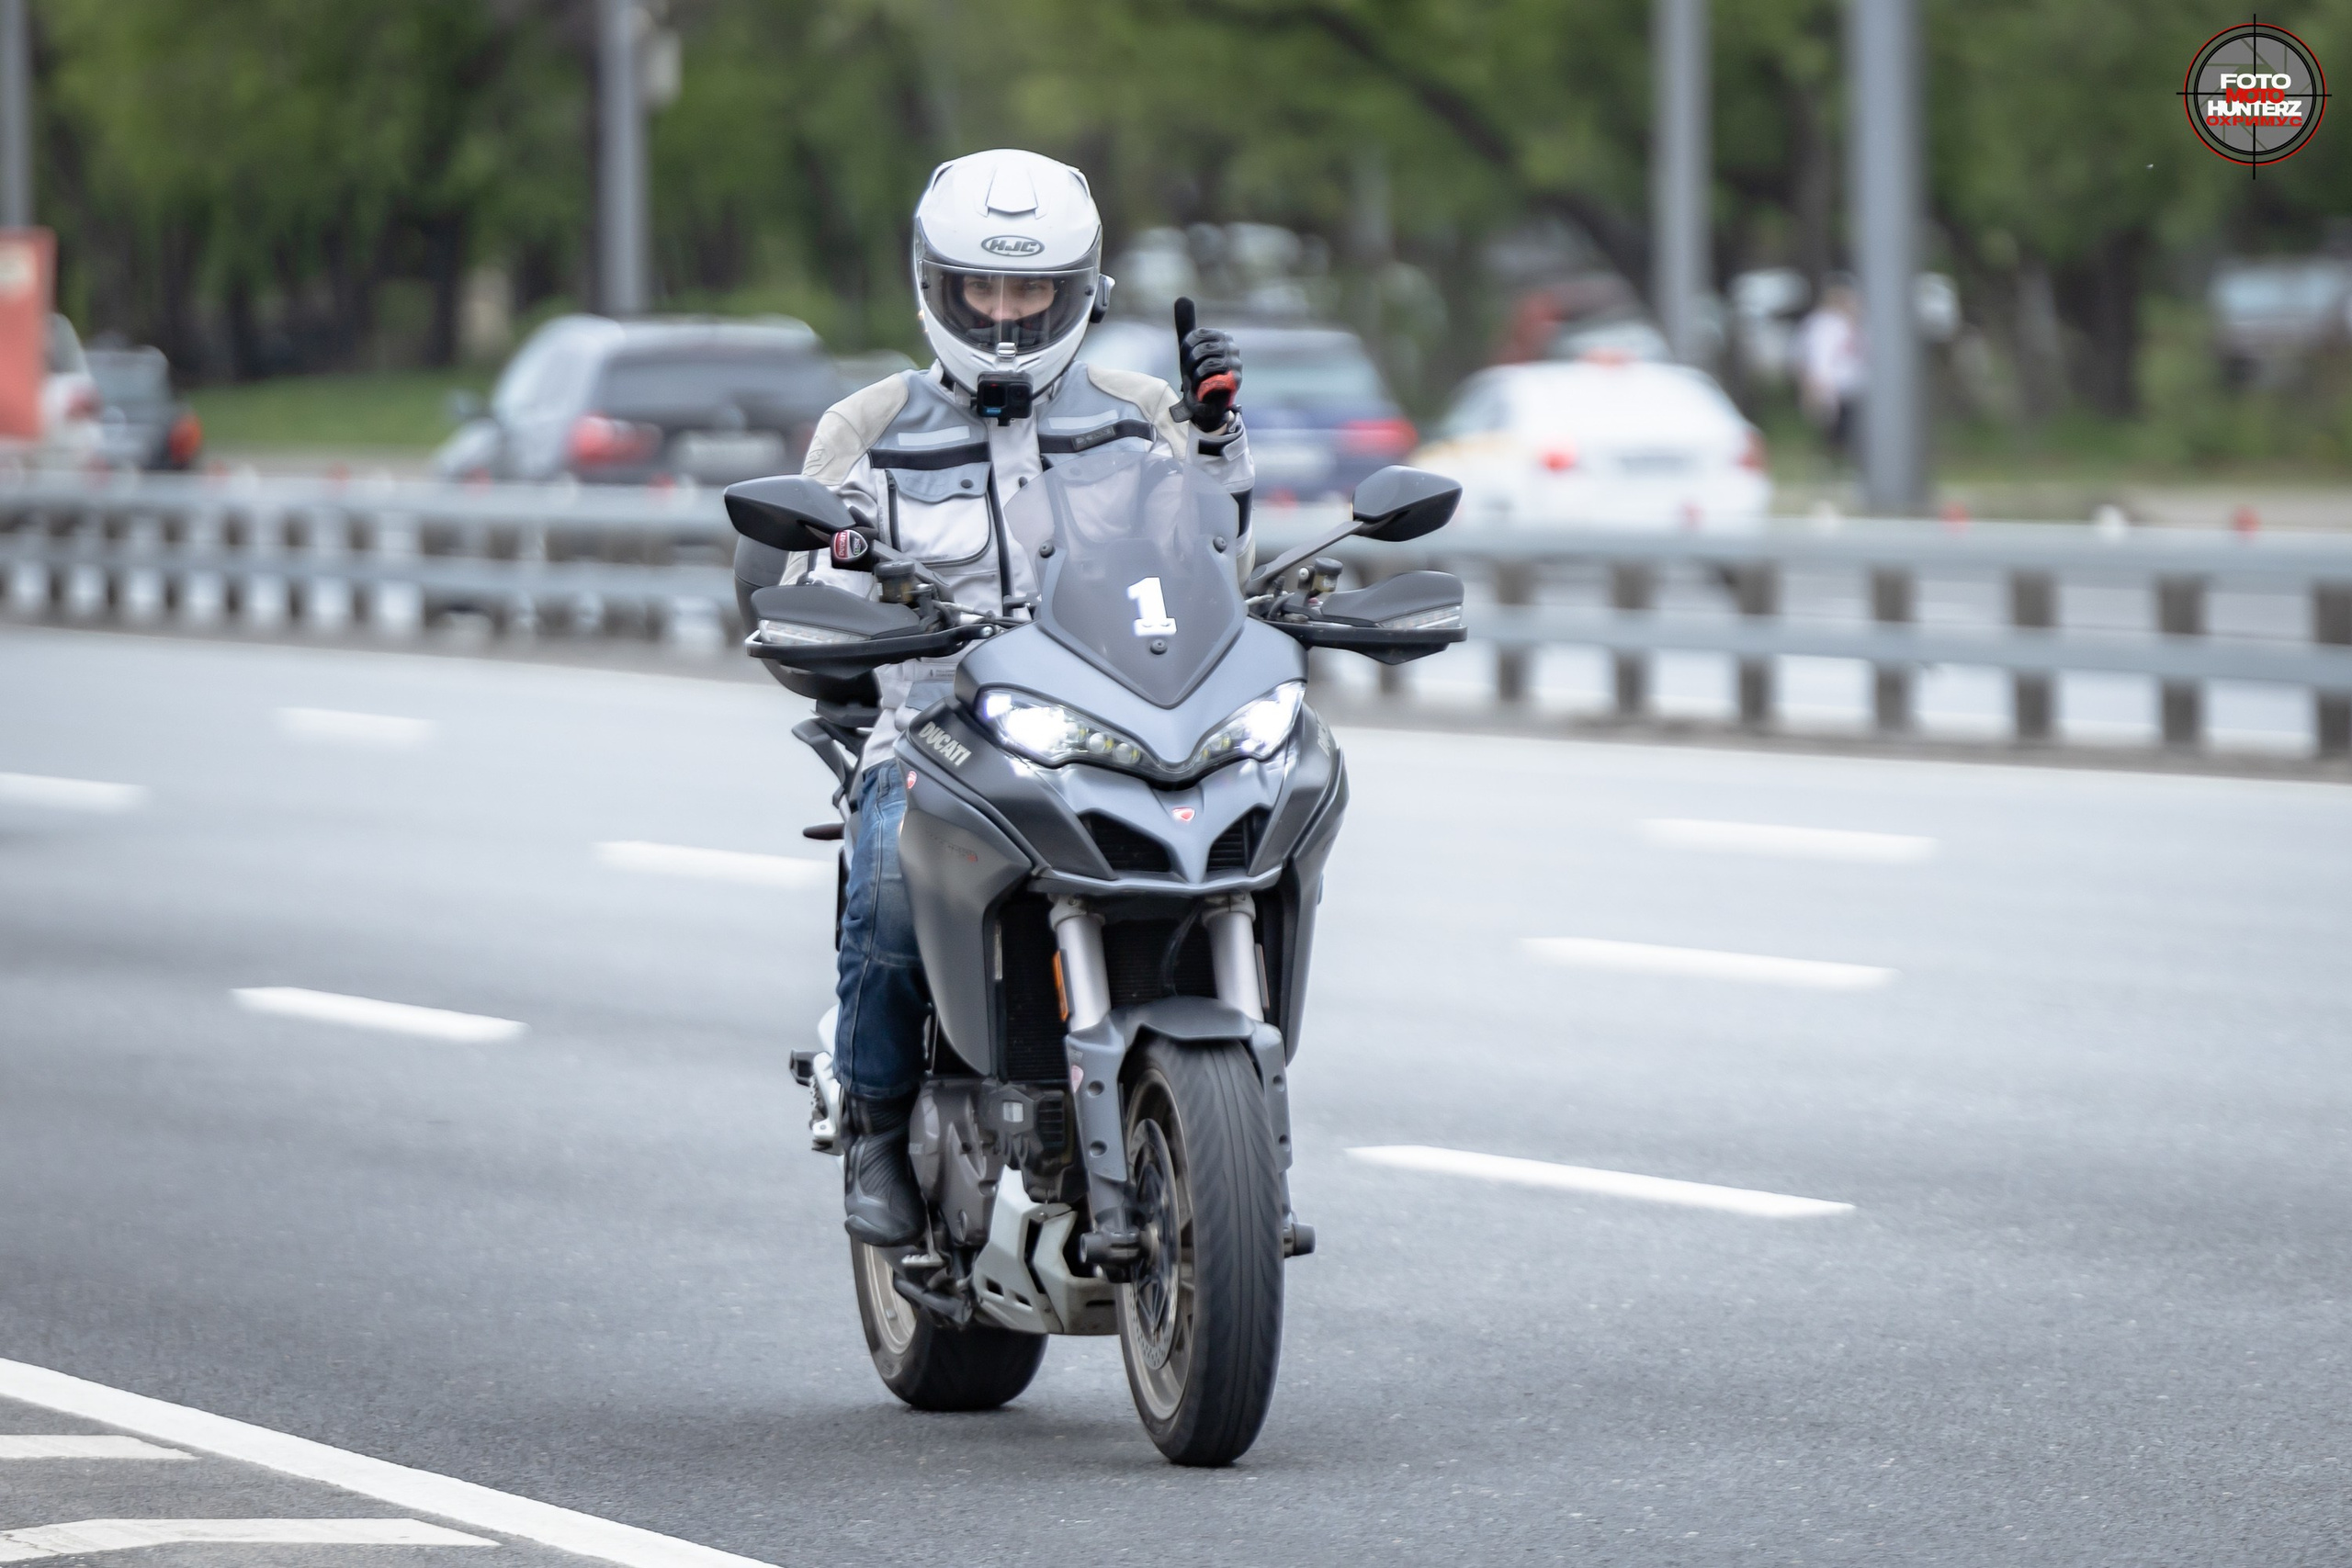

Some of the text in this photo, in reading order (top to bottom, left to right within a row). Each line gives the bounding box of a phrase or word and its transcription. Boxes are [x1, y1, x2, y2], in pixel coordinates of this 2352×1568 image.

[989, 239, 1037, 252] HJC
[837, 532, 847, 557] DUCATI
[1126, 577, 1177, 637] 1
[919, 721, 972, 766] DUCATI
